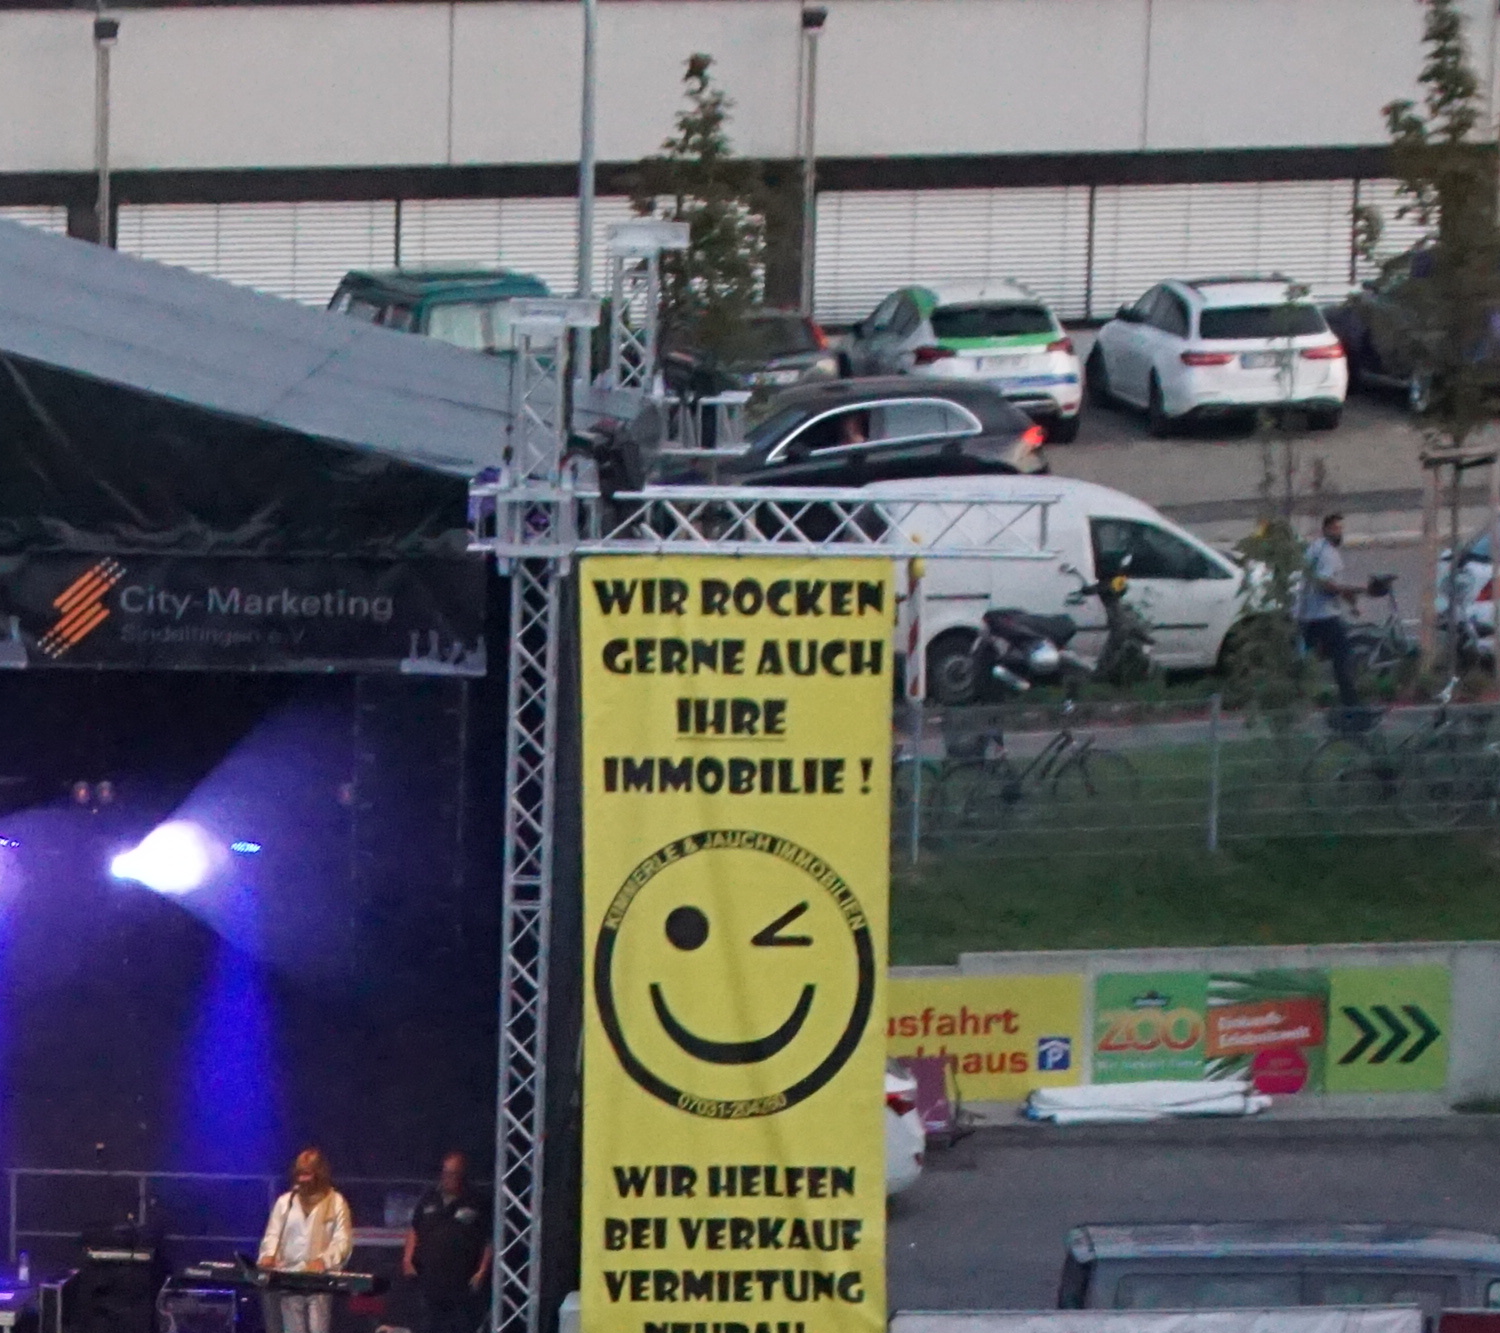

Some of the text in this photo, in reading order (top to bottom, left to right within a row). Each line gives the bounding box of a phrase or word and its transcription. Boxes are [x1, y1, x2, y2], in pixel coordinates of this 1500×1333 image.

[120, 585, 393, 622] City-Marketing
[593, 578, 886, 616] WIR ROCKEN
[602, 638, 884, 676] GERNE AUCH
[676, 698, 788, 735] IHRE
[603, 757, 873, 795] IMMOBILIE !
[703, 830, 771, 854] JAUCH
[773, 841, 866, 931] IMMOBILIEN
[1097, 1009, 1205, 1053] ZOO
[612, 1166, 855, 1198] WIR HELFEN
[604, 1218, 862, 1252] BEI VERKAUF
[602, 1270, 865, 1303] VERMIETUNG
